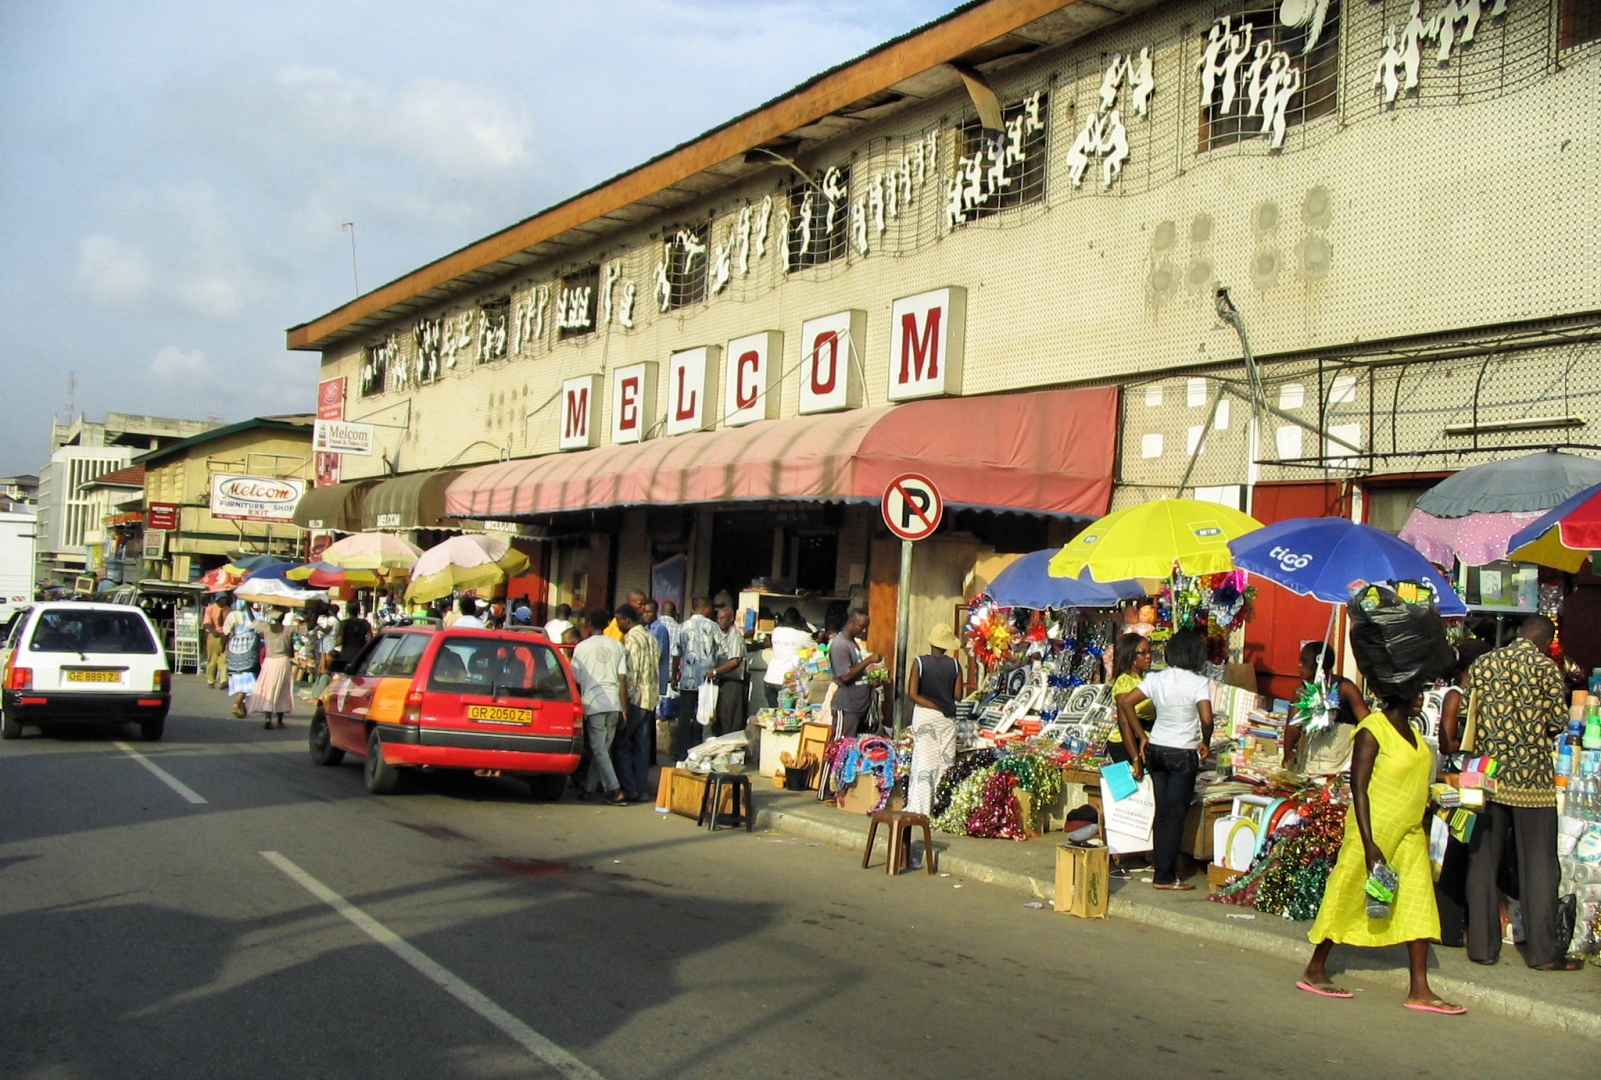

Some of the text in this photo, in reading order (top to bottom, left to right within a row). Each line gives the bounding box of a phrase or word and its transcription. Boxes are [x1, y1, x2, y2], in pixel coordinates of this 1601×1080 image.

[564, 306, 942, 439] MELCOM
[329, 425, 368, 441] Melcom
[222, 482, 289, 499] Melcom
[219, 501, 294, 512] FURNITURE SHOP
[471, 707, 525, 721] GR 2050 Z
